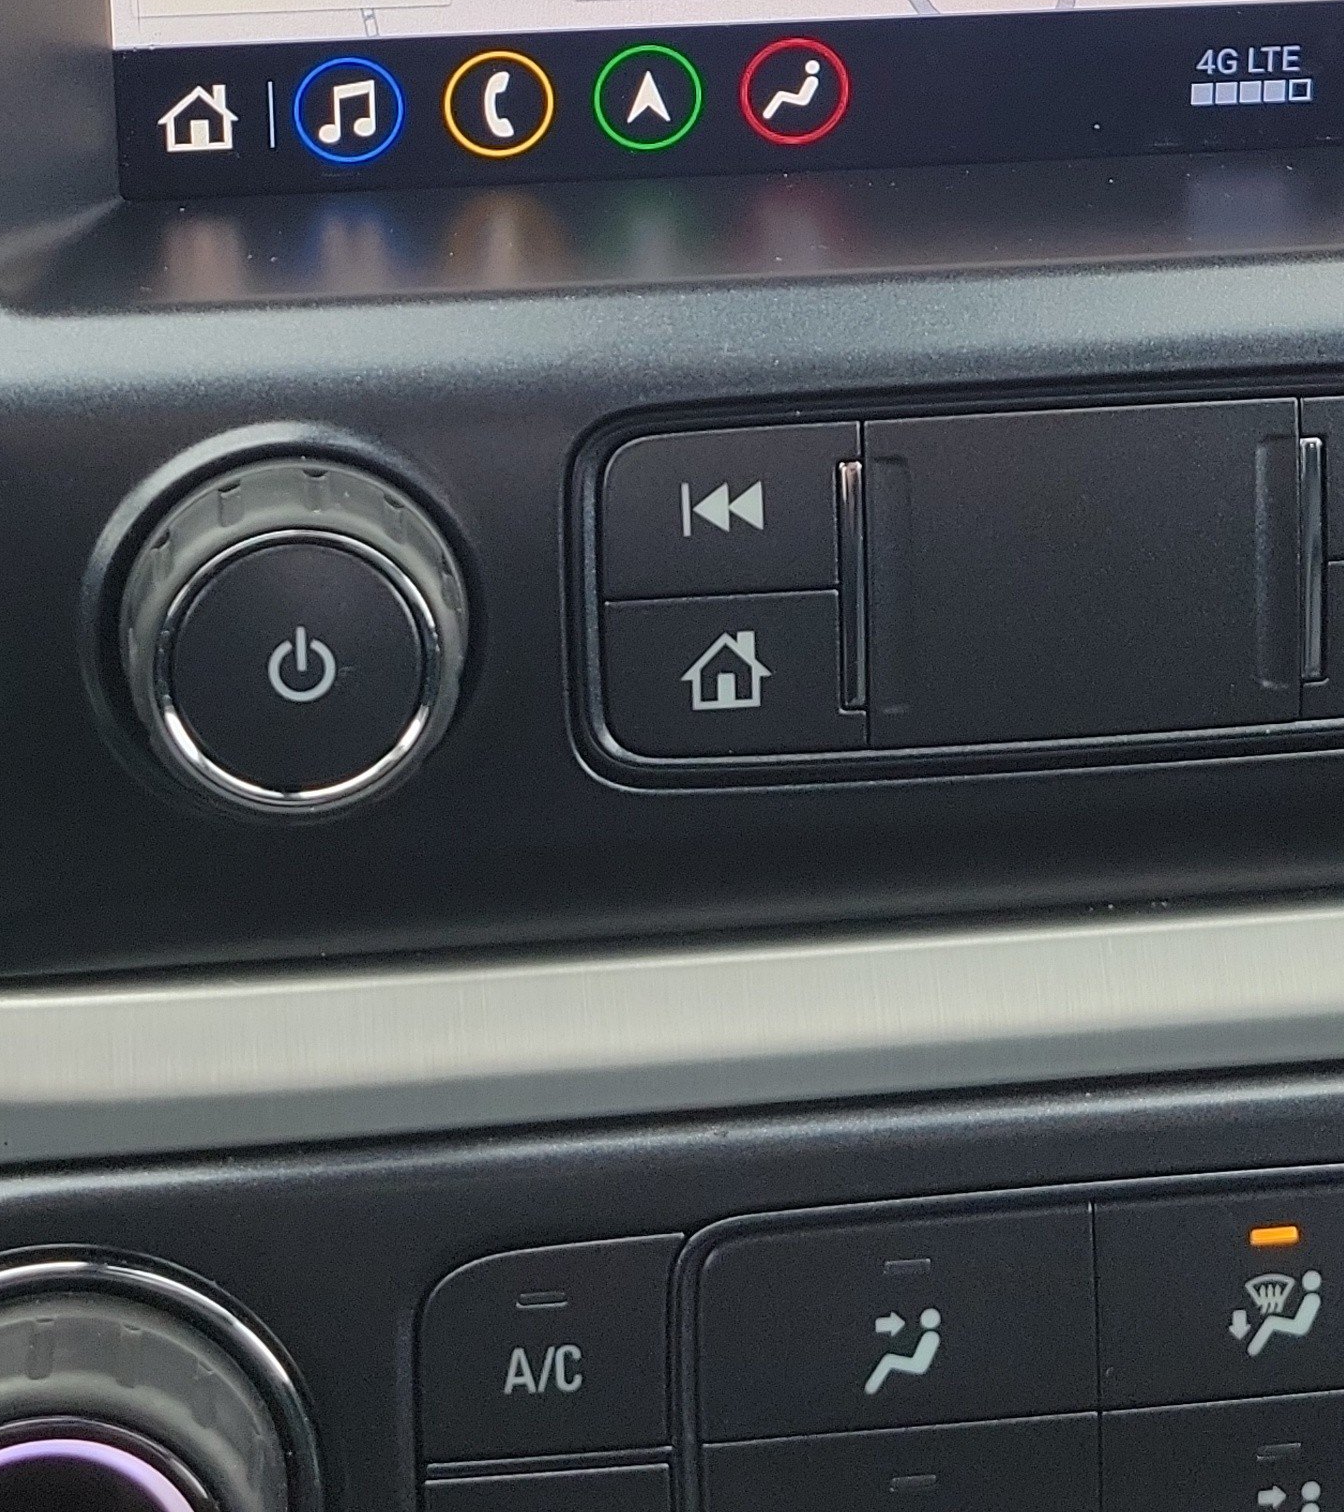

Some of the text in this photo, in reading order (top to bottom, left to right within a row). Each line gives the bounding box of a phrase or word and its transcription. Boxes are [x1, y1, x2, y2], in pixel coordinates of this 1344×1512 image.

[1196, 45, 1301, 74] 4G LTE
[504, 1344, 583, 1394] A/C
